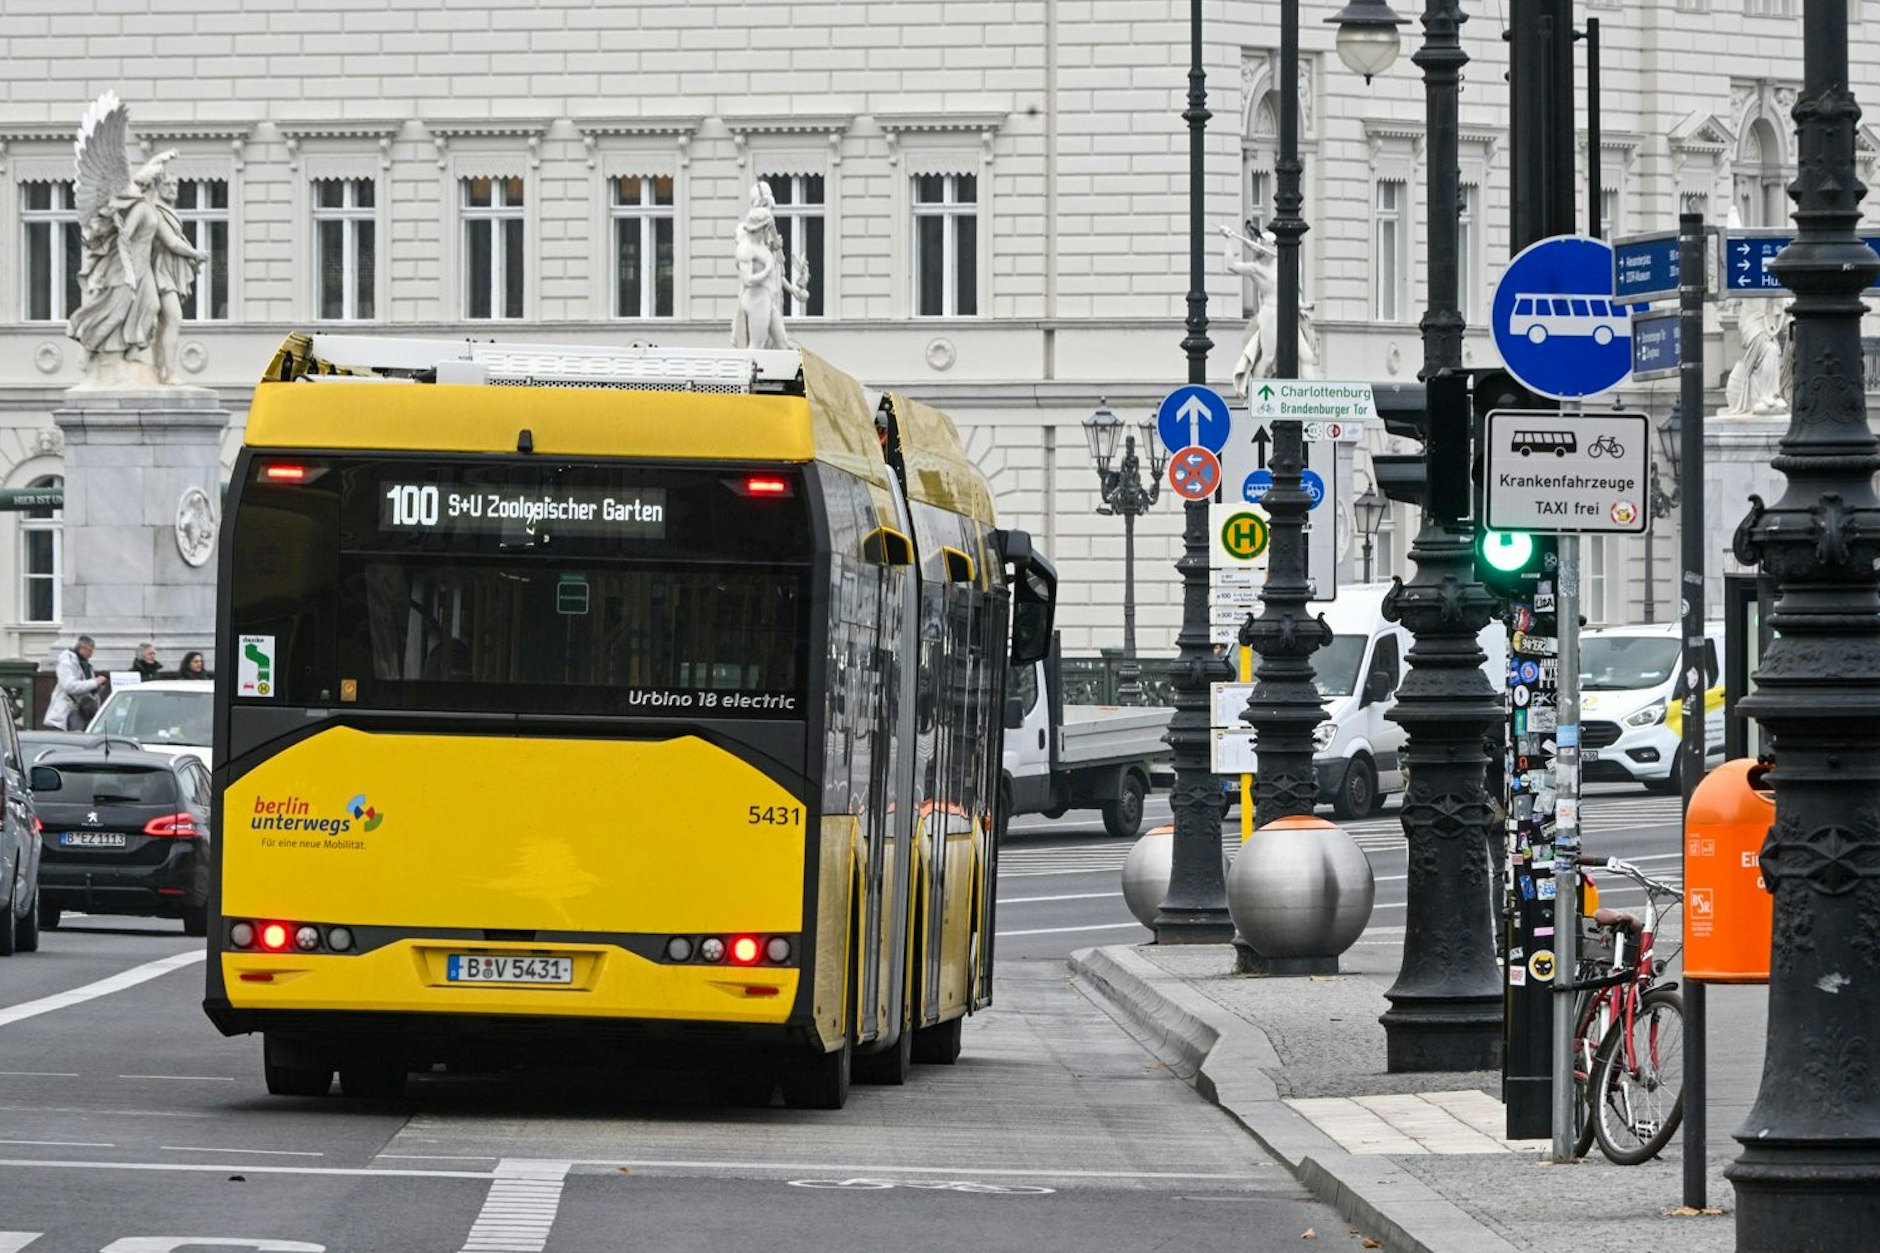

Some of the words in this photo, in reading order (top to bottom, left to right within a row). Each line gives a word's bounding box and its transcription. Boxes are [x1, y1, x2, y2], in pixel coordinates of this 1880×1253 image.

[1281, 385, 1371, 401] Charlottenburg
[1280, 402, 1350, 417] Brandenburger
[1353, 403, 1367, 415] Tor
[1500, 473, 1635, 492] Krankenfahrzeuge
[386, 484, 440, 526] 100
[448, 493, 482, 517] S+U
[487, 494, 598, 524] Zoologischer
[602, 497, 663, 522] Garten
[1535, 501, 1567, 515] TAXI
[1574, 502, 1600, 515] frei
[629, 690, 693, 707] Urbino
[698, 692, 718, 708] 18
[721, 693, 796, 710] electric
[254, 795, 310, 815] berlin
[251, 814, 351, 836] unterwegs
[748, 805, 800, 826] 5431
[67, 832, 74, 843] B
[261, 837, 275, 848] Für
[278, 839, 297, 849] eine
[299, 841, 322, 850] neue
[324, 841, 367, 851] Mobilität.
[467, 958, 480, 978] B
[495, 959, 508, 979] V
[512, 960, 562, 980] 5431
